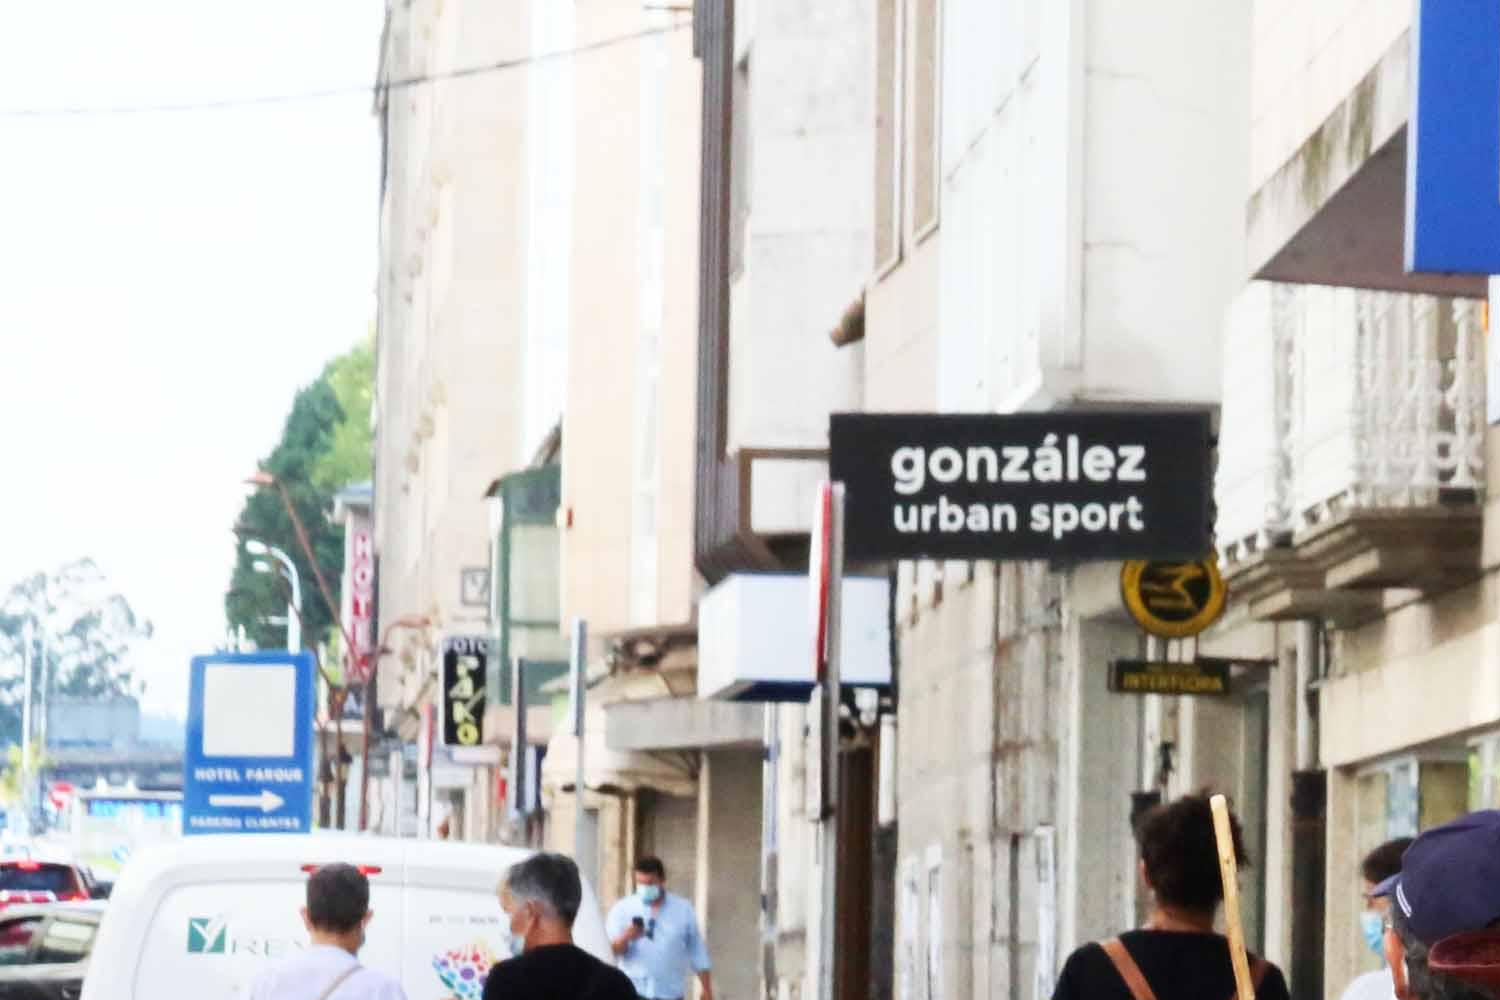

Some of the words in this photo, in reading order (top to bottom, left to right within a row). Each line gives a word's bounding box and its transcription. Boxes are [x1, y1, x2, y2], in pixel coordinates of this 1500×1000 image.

[891, 432, 1146, 495] gonzález
[894, 495, 1017, 532] urban
[1030, 496, 1144, 540] sport
[194, 767, 241, 781] HOTEL
[245, 767, 303, 781] PARQUE
